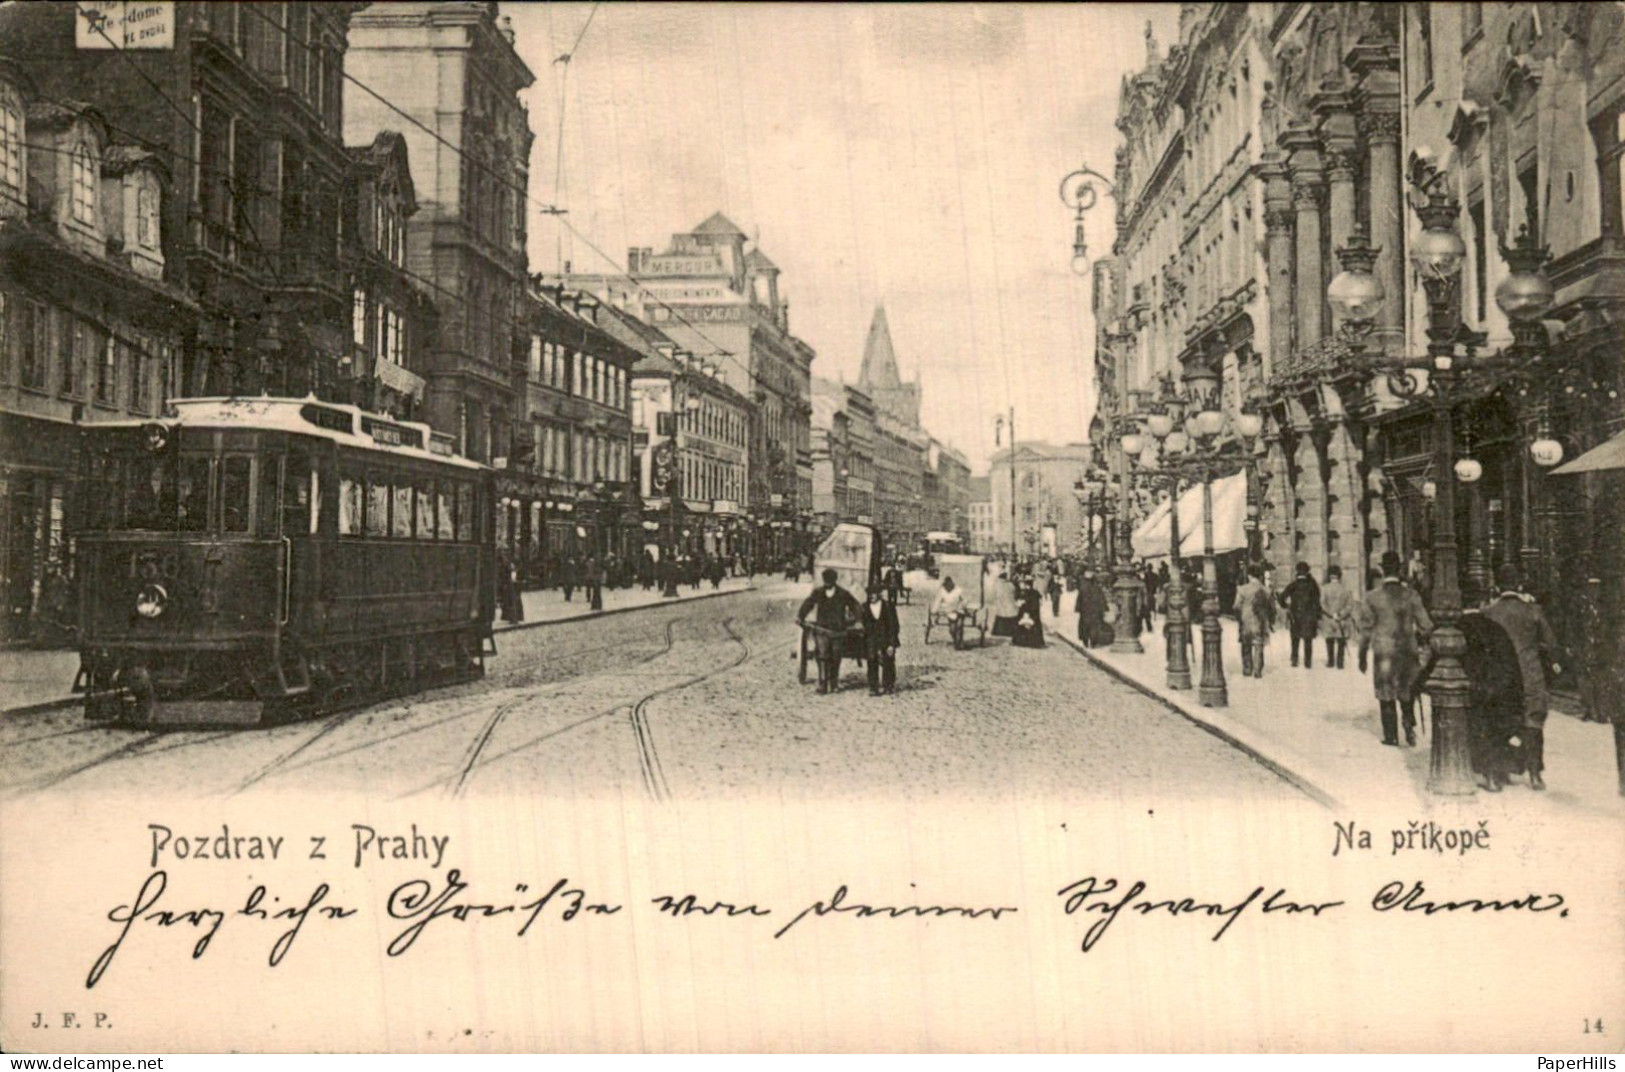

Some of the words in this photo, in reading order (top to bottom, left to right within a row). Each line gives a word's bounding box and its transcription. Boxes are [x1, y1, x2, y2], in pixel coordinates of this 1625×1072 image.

[651, 260, 713, 274] MERCUR
[148, 824, 284, 868] Pozdrav
[309, 836, 327, 860] z
[352, 824, 450, 868] Prahy
[1332, 821, 1372, 856] Na
[1391, 820, 1490, 856] příkopě
[31, 1012, 49, 1029] J.
[62, 1012, 81, 1029] F.
[94, 1012, 112, 1029] P.
[1583, 1017, 1604, 1034] 14
